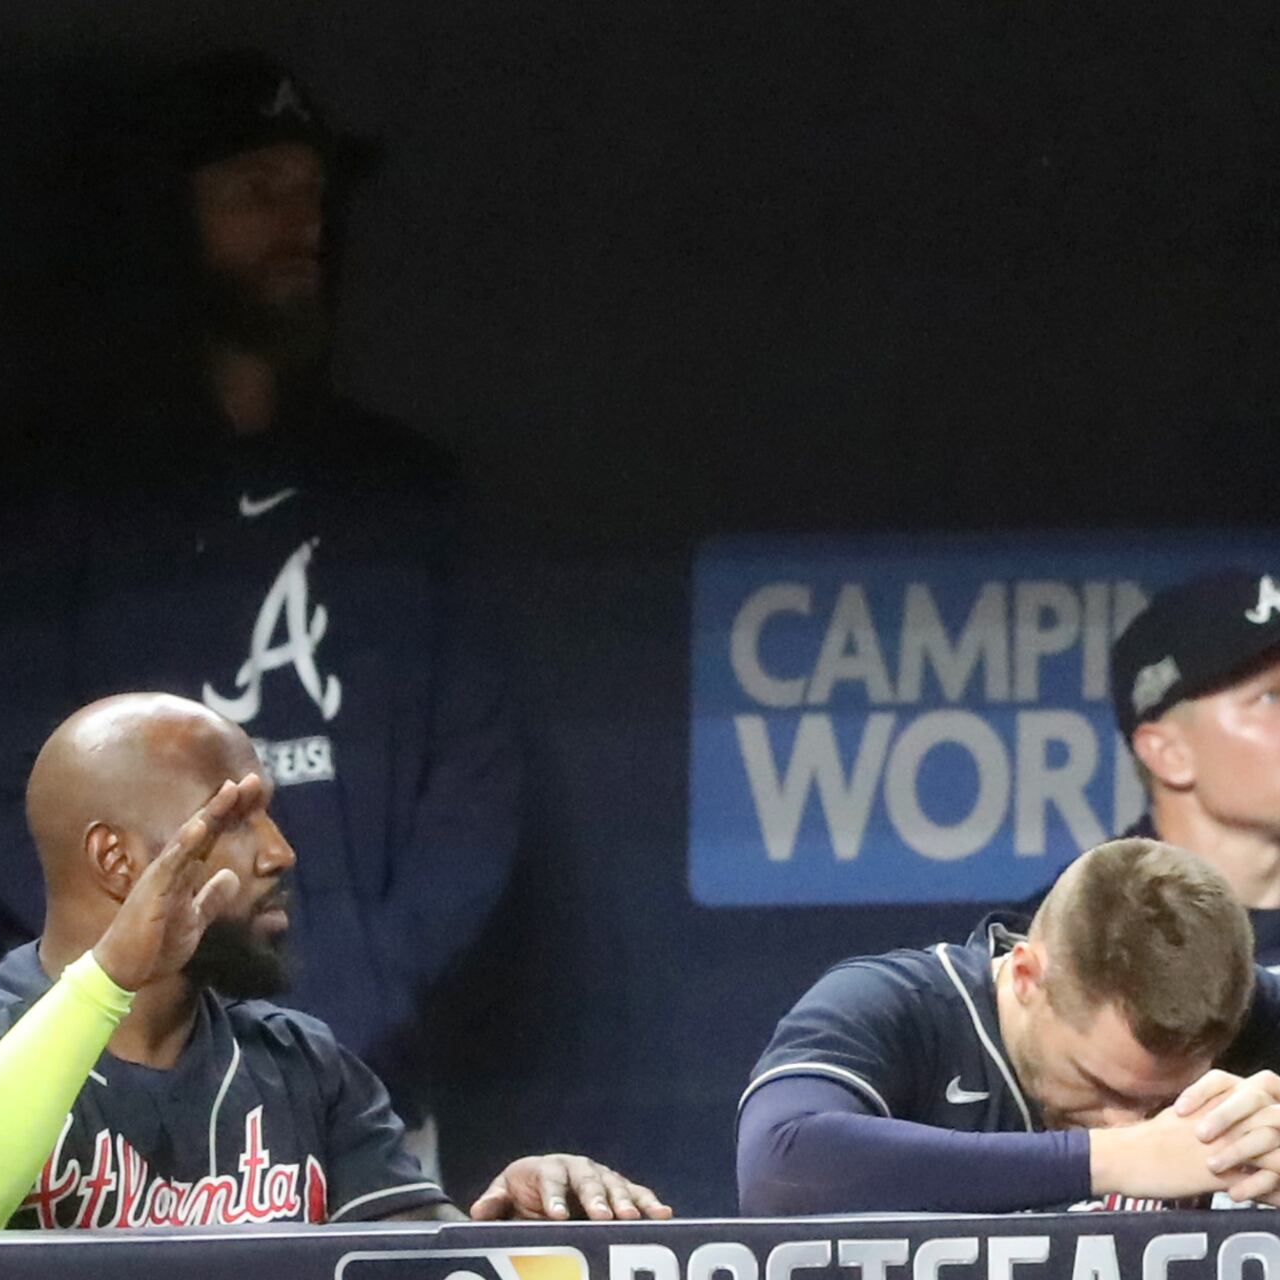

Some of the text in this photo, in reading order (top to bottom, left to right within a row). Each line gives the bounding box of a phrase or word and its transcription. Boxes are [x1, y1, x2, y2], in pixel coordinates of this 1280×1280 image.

[202, 537, 342, 724] A
[730, 580, 1150, 708] CAMPI
[734, 707, 1148, 861] WOR
